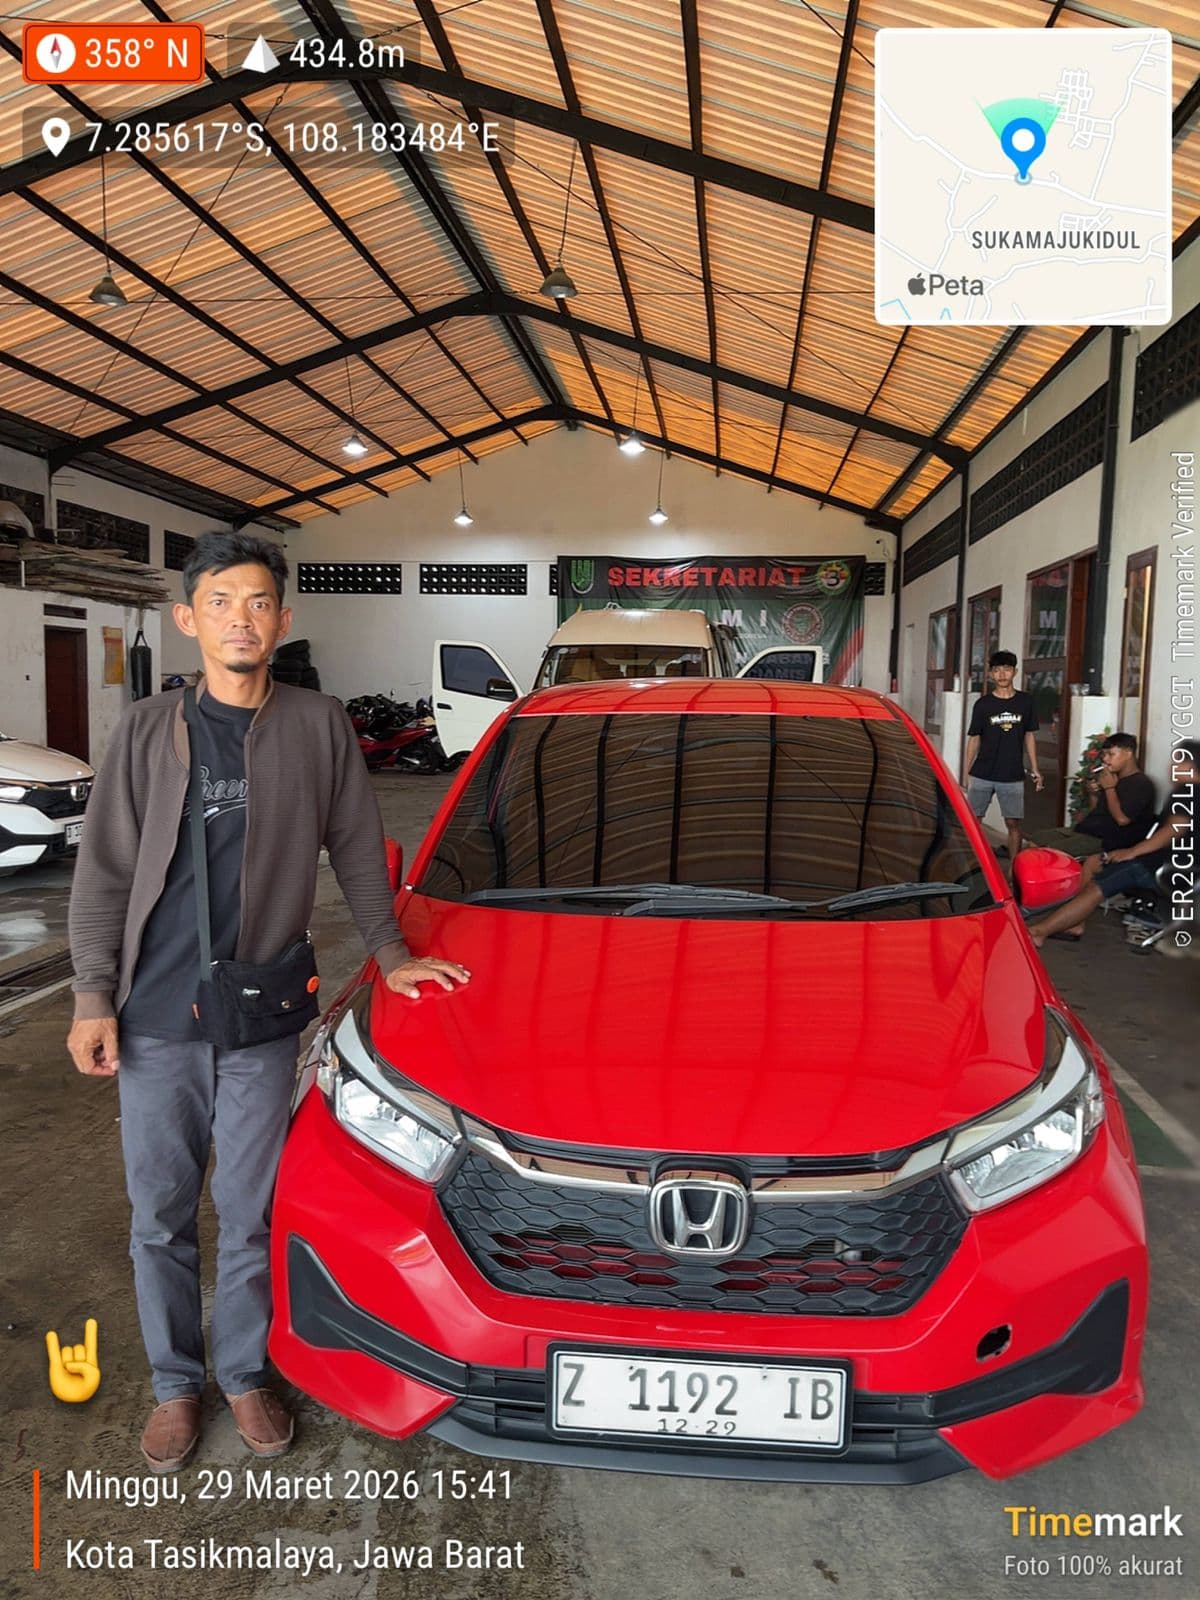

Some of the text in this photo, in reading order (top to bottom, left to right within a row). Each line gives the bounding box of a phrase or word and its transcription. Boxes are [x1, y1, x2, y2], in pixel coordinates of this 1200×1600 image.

[607, 566, 807, 587] SEKRETARIAT
[561, 1362, 835, 1421] Z 1192 IB
